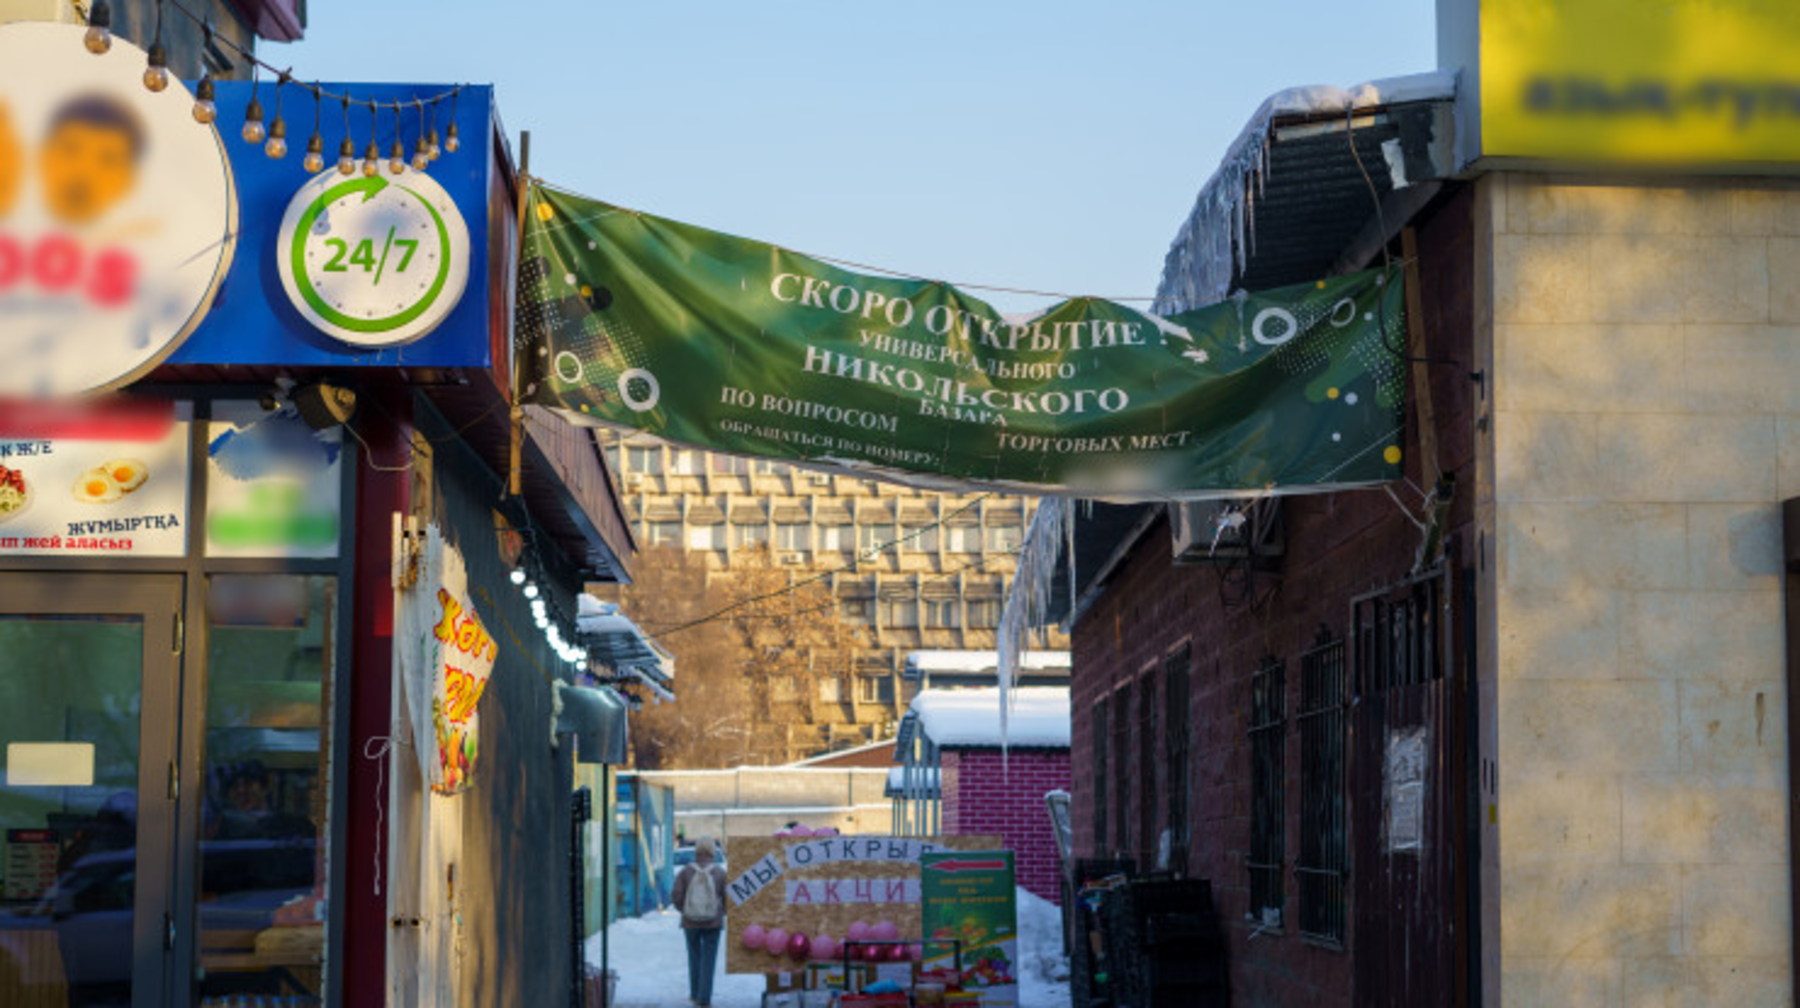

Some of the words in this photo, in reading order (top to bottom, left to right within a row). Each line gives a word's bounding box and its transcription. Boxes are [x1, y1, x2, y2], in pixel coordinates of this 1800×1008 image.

[323, 225, 419, 286] 24/7
[770, 273, 914, 328] СКОРО
[925, 304, 1146, 350] ОТКРЫТИЕ
[859, 329, 1076, 379] УНИВЕРСАЛЬНОГО
[803, 345, 1129, 415] НИКОЛЬСКОГО
[720, 386, 755, 408] ПО
[761, 393, 898, 433] ВОПРОСОМ
[996, 432, 1124, 453] ТОРГОВЫХ
[1128, 430, 1191, 450] МЕСТ
[918, 399, 1008, 427] БАЗАРА
[16, 440, 53, 457] Ж/Е
[720, 418, 833, 449] ОБРАЩАТЬСЯ
[838, 438, 861, 452] ПО
[865, 444, 941, 466] НОМЕРУ:
[22, 535, 61, 549] жей
[65, 536, 133, 550] аласыз
[731, 859, 778, 901] МЫ
